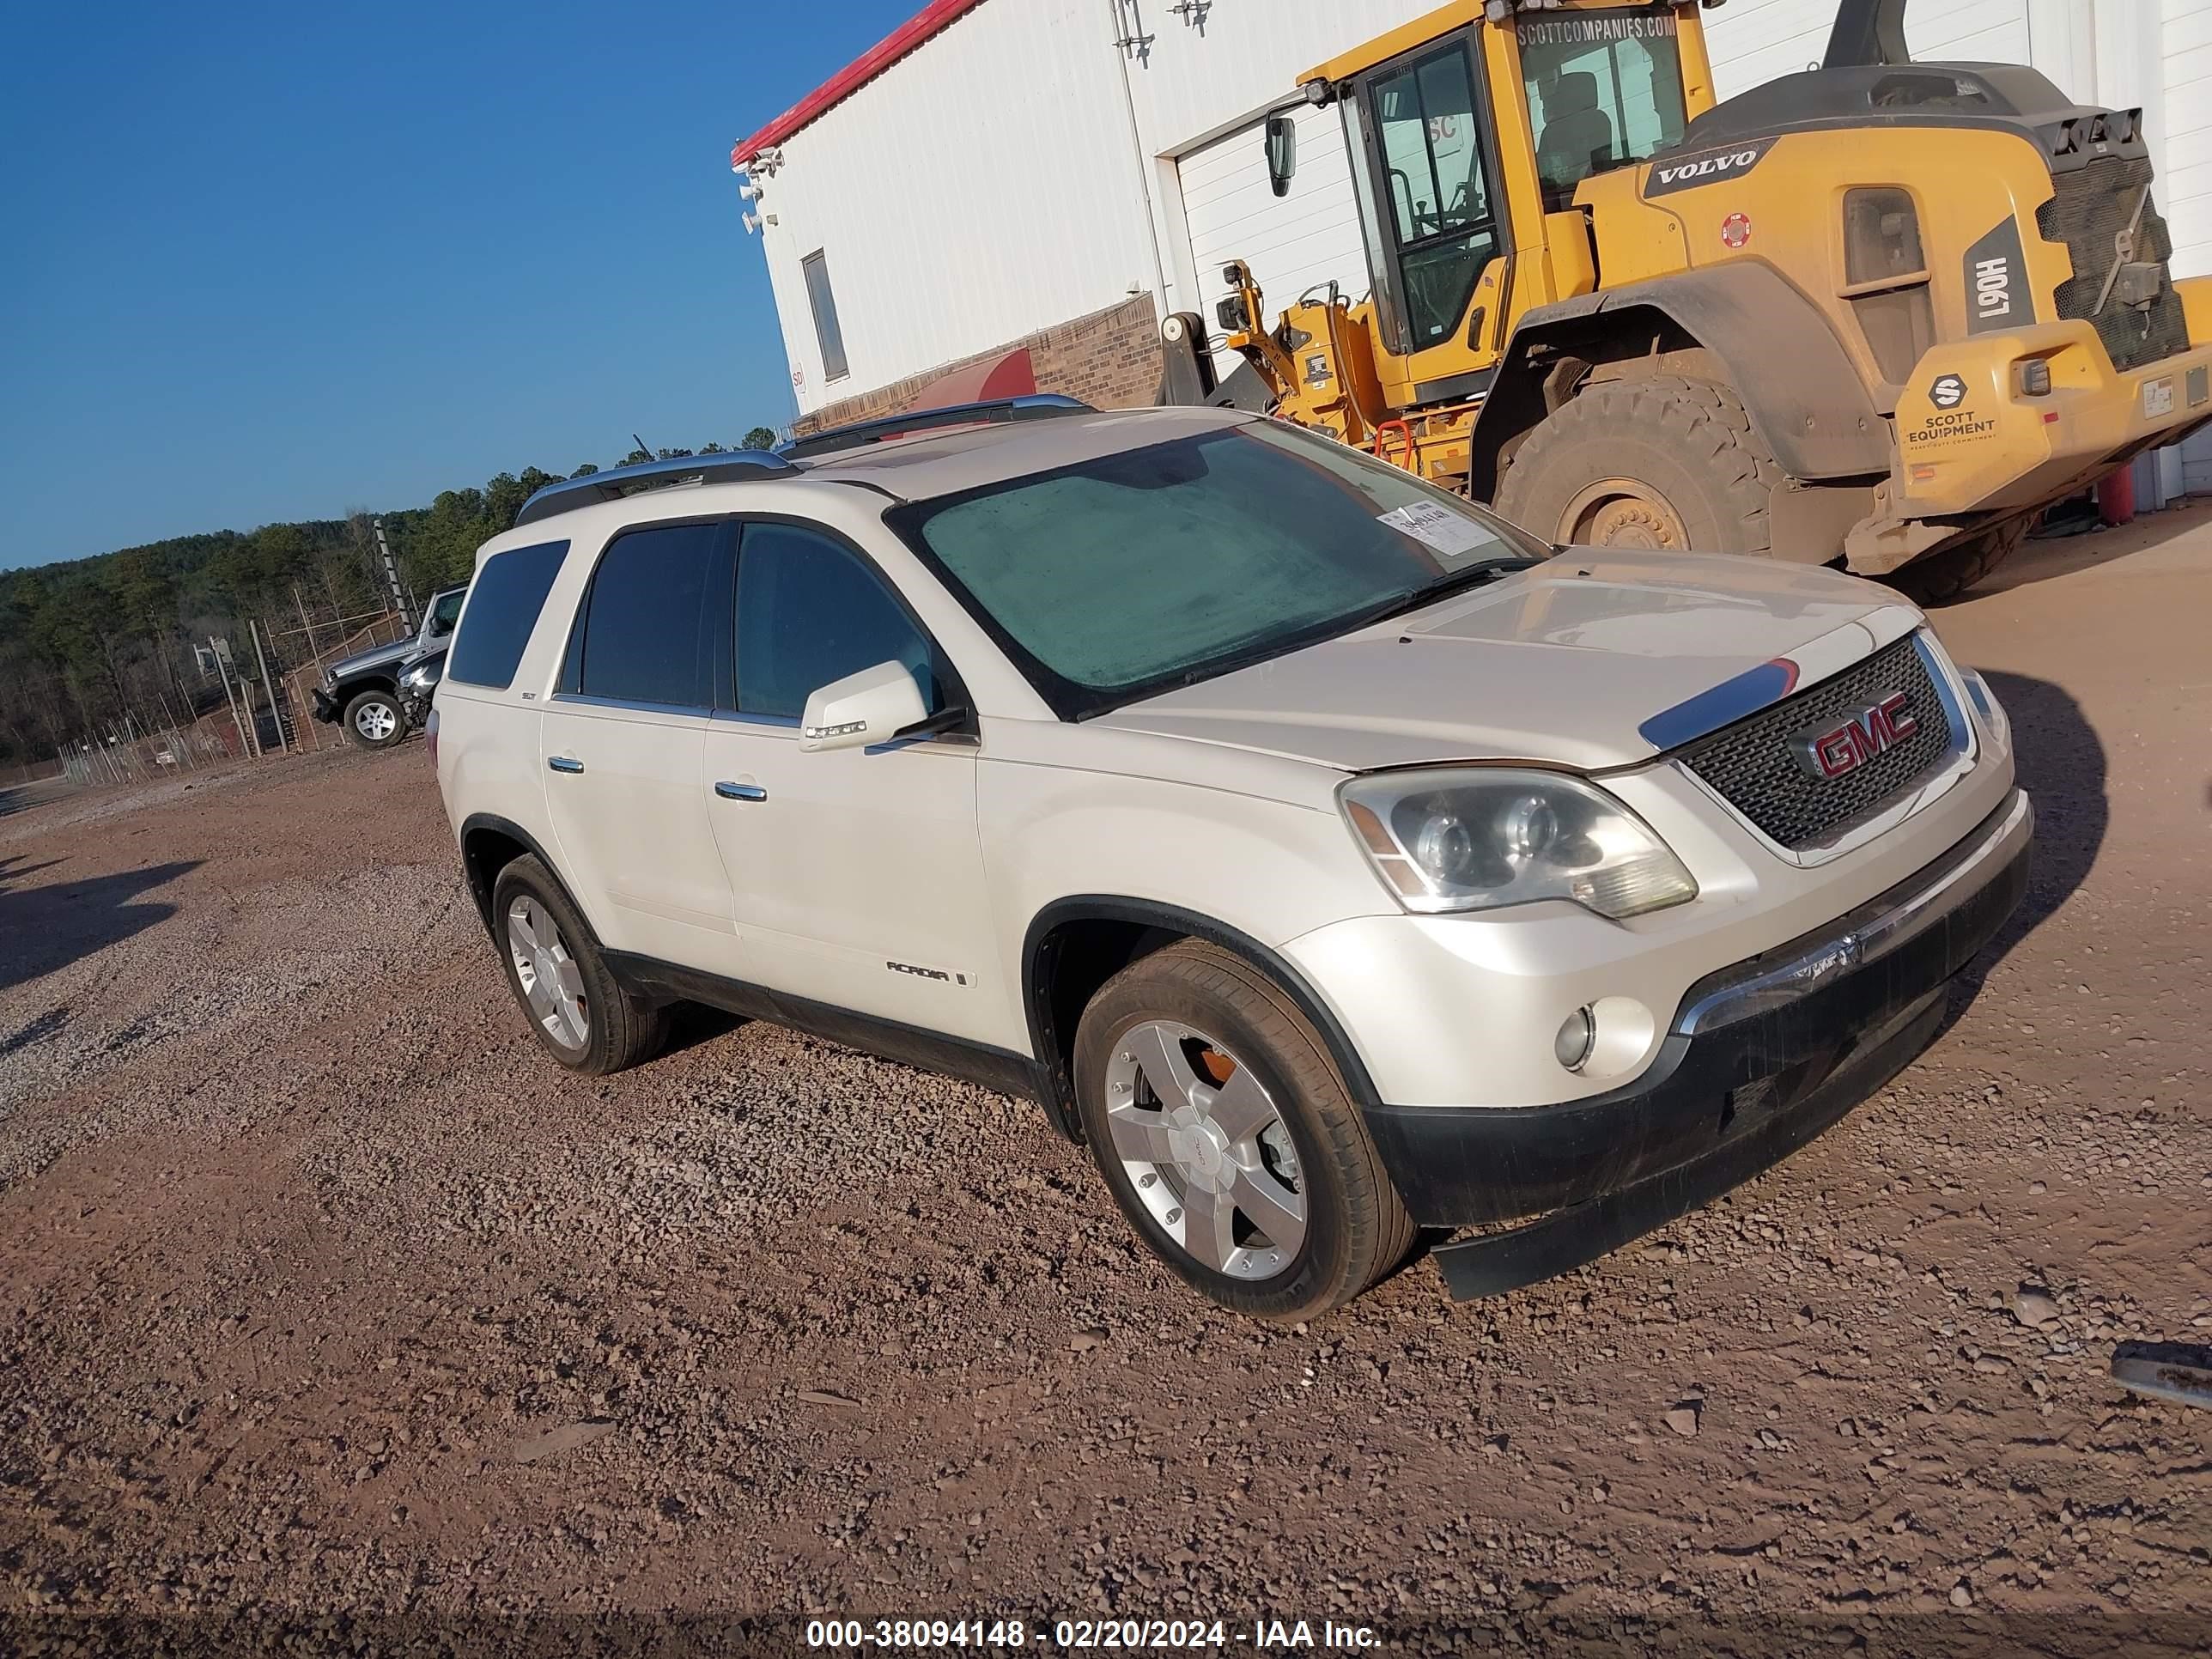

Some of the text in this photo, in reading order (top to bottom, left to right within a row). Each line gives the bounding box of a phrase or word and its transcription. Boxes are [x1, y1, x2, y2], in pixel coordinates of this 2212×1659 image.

[1517, 15, 1676, 46] SCOTTCOMPANIES.COM
[1658, 150, 1757, 184] VOLVO
[1976, 257, 2010, 319] L90H
[793, 371, 803, 386] SD
[1909, 420, 1996, 442] EQUIPMENT
[1925, 411, 1974, 428] SCOTT
[1809, 690, 1918, 780] GMC
[886, 961, 950, 981] ACADIA
